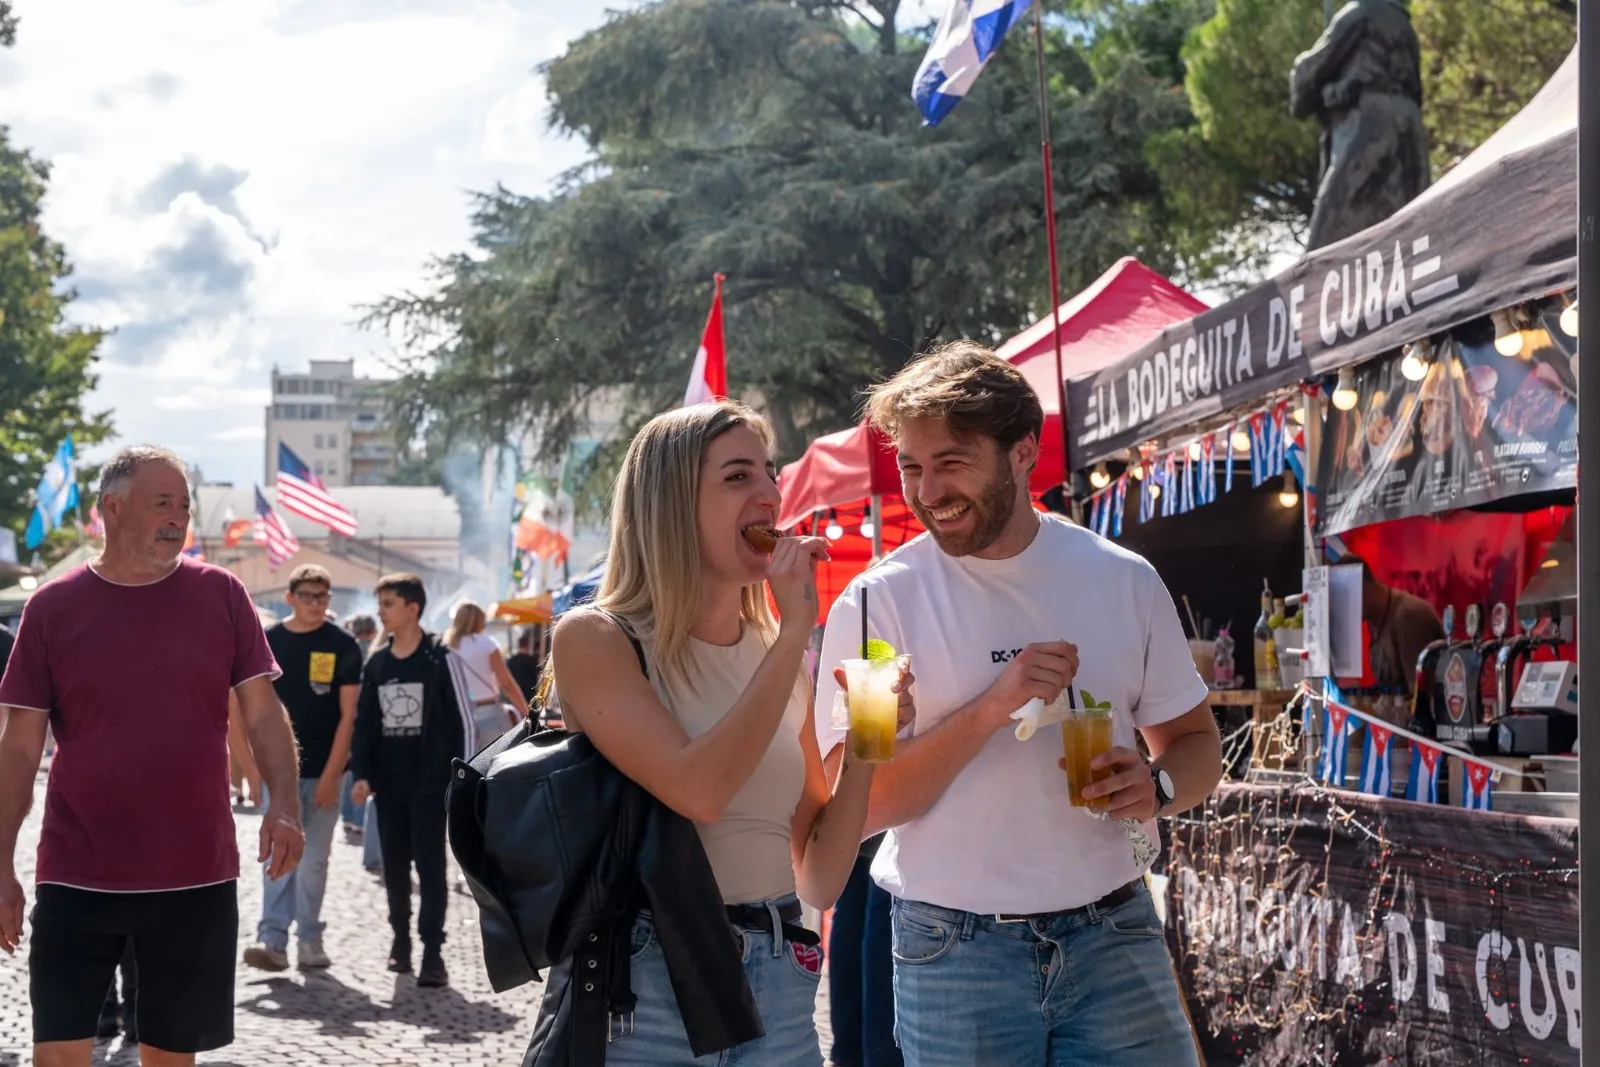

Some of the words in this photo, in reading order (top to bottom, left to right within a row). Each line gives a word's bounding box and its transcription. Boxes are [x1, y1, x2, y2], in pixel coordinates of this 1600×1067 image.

[1098, 380, 1120, 440] LA
[1127, 313, 1255, 427] BODEGUITA
[1266, 284, 1305, 369] DE
[1319, 239, 1412, 346] CUBA
[991, 648, 1024, 663] DC-1
[1383, 912, 1450, 1014] DE
